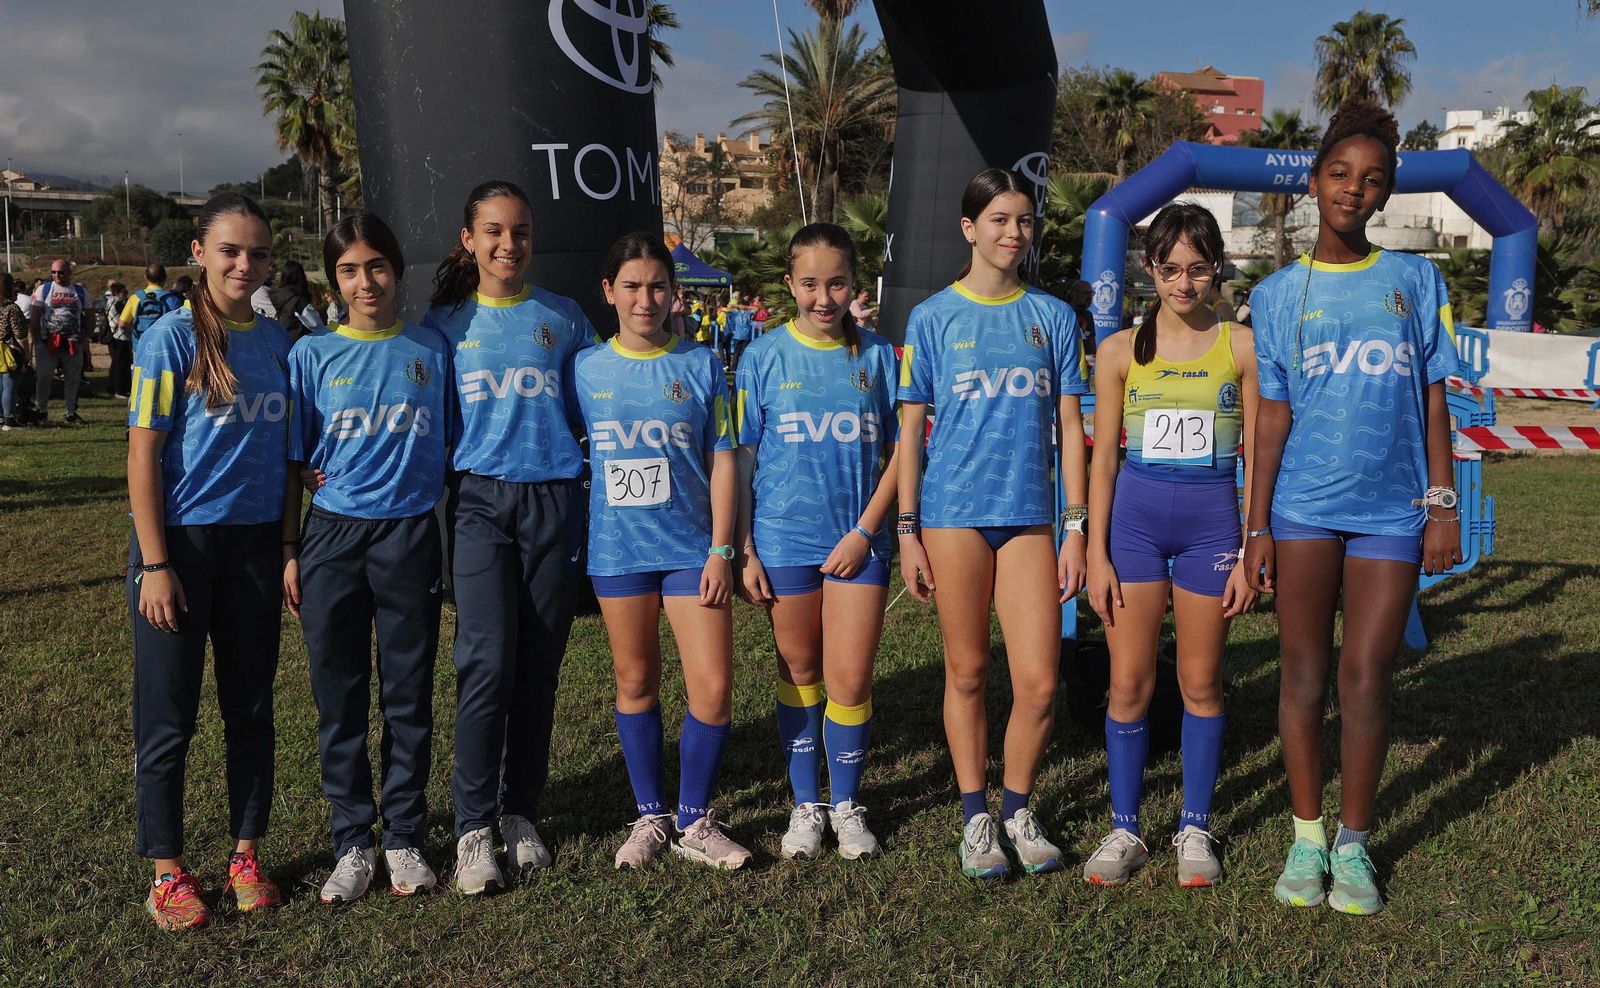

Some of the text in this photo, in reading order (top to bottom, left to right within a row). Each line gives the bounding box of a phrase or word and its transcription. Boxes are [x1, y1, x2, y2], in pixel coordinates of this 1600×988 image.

[531, 143, 660, 206] TOM
[1273, 172, 1310, 185] DE A
[951, 339, 977, 351] vive
[1302, 340, 1415, 378] EVOS
[460, 367, 559, 404] EVOS
[779, 379, 803, 391] vive
[952, 367, 1051, 400] EVOS
[1182, 369, 1208, 378] rasán
[205, 391, 287, 426] EVO
[592, 390, 615, 399] vive
[326, 403, 431, 440] EVOS
[591, 420, 692, 450] EVOS
[777, 412, 880, 442] EVOS
[1152, 414, 1207, 453] 213
[611, 465, 661, 500] 307
